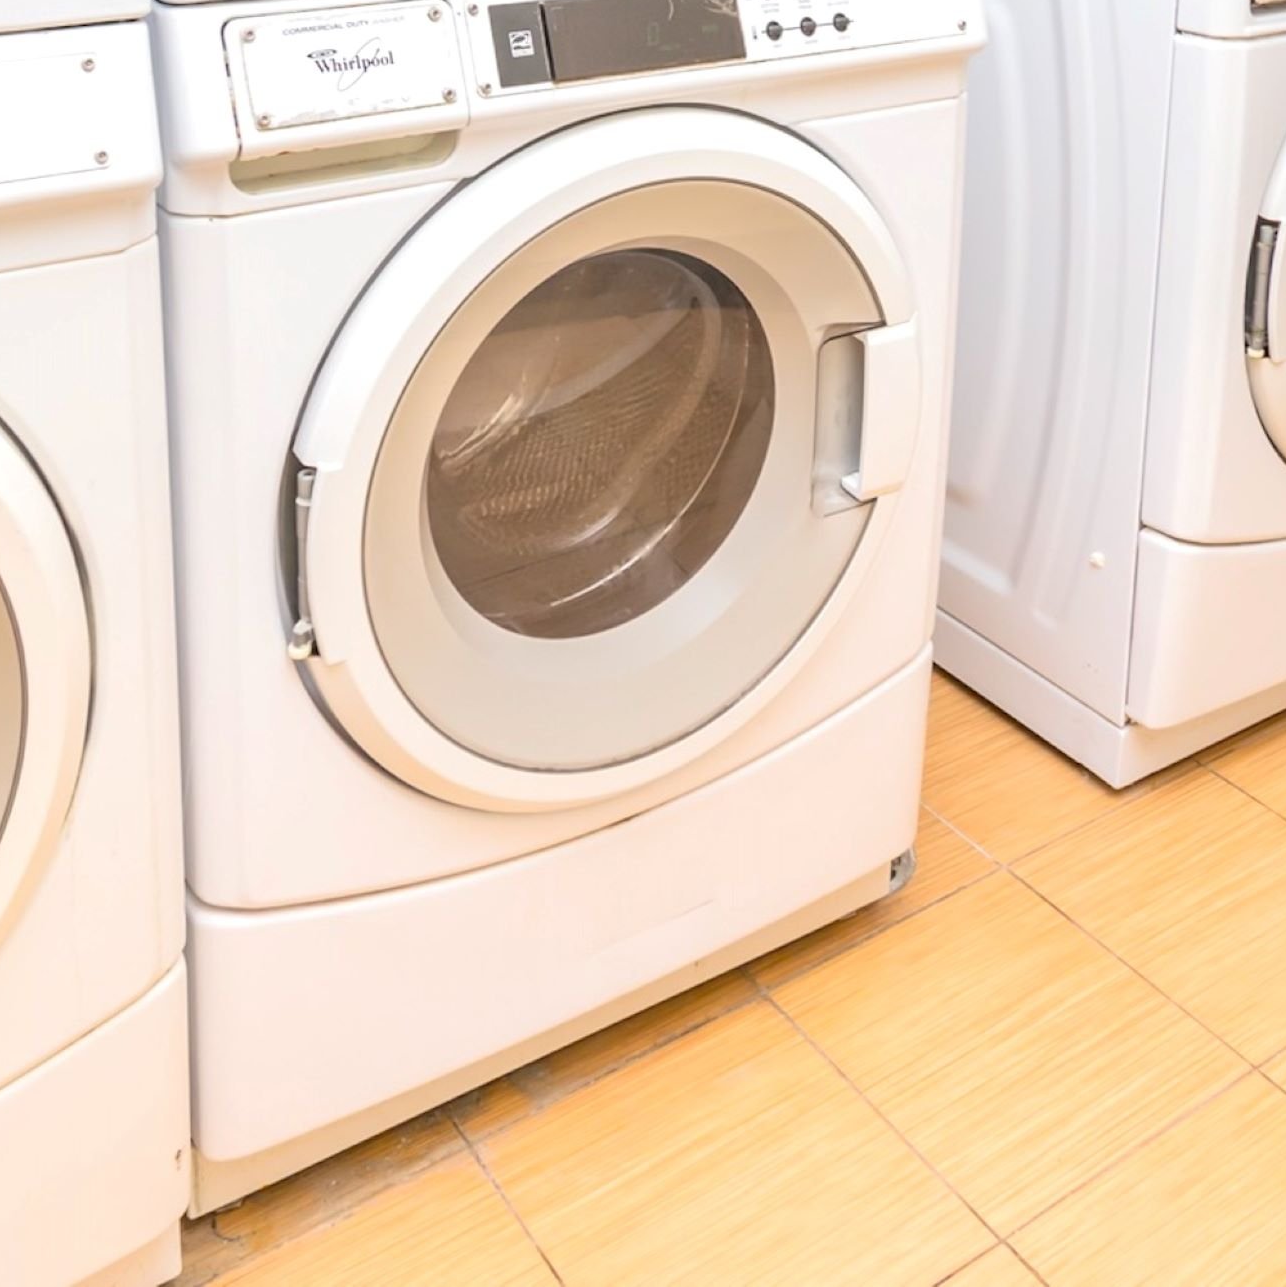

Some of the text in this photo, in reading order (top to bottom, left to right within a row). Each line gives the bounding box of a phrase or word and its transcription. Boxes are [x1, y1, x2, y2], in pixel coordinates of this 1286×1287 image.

[282, 22, 344, 36] COMMERCIAL
[346, 19, 369, 29] DUTY
[315, 50, 395, 74] Whirlpool
